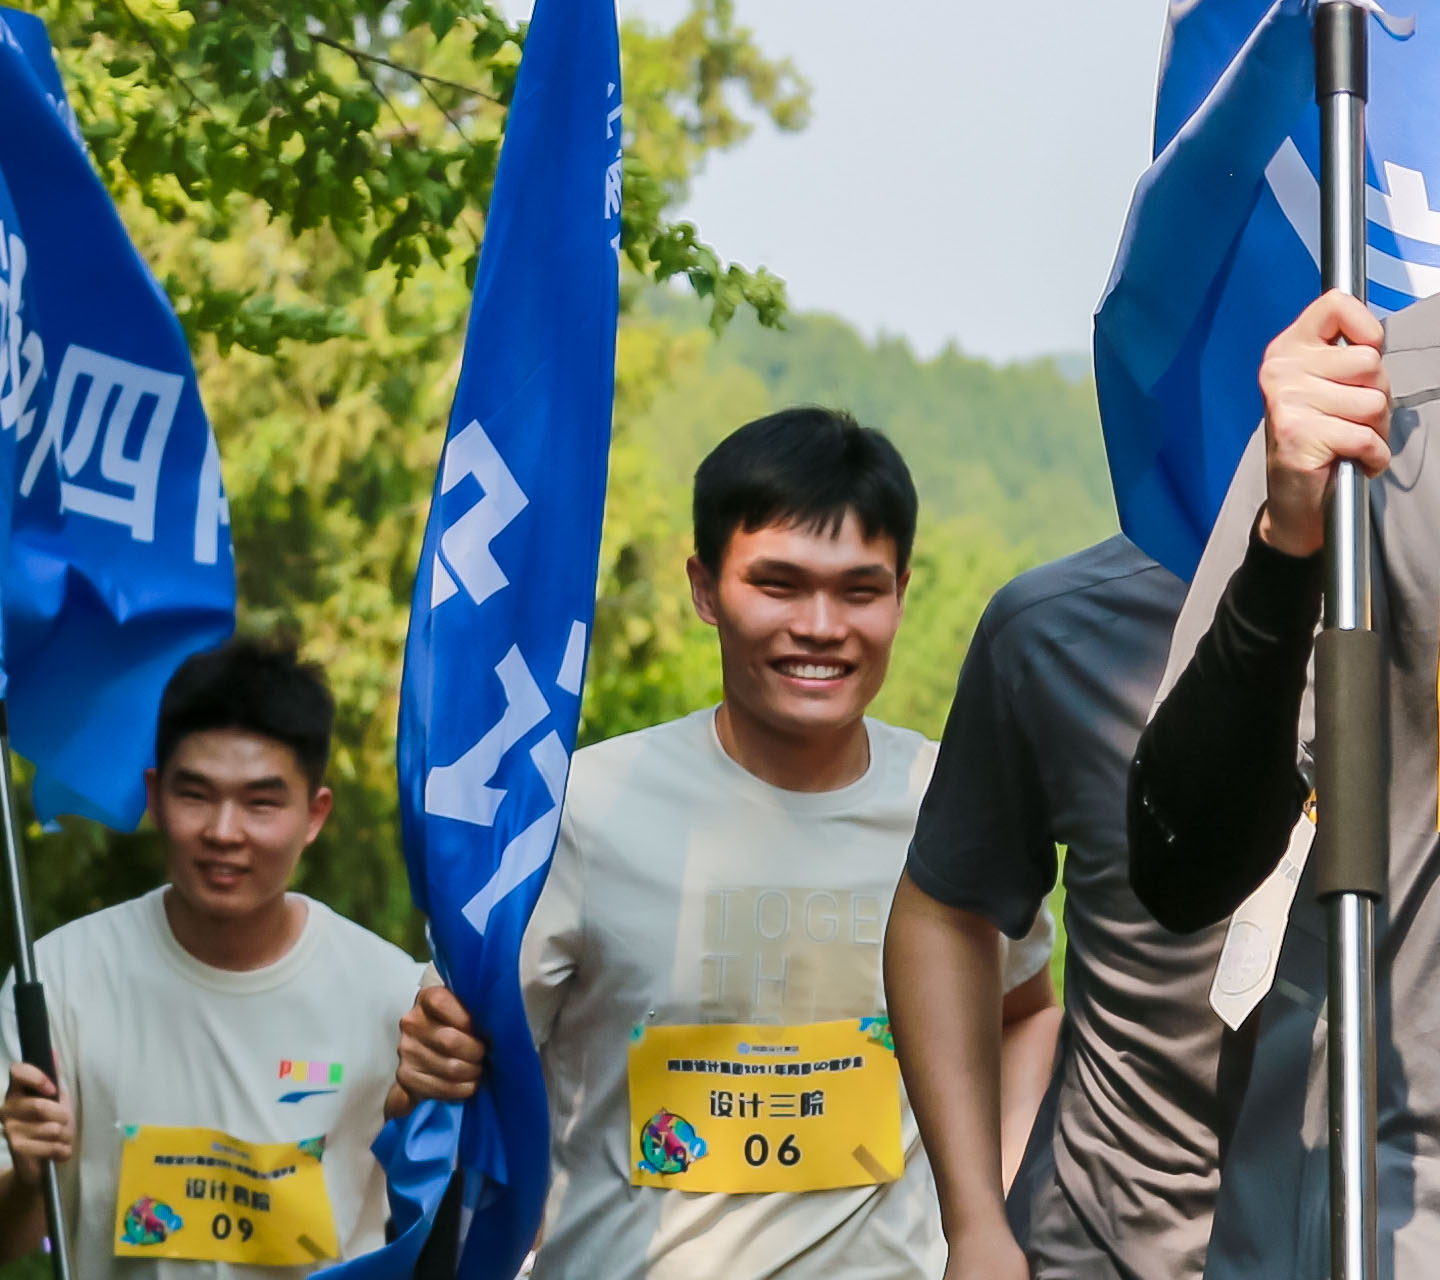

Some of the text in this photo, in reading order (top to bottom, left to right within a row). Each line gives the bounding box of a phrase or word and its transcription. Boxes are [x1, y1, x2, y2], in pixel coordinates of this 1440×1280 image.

[709, 1089, 825, 1119] 设计三院
[744, 1133, 802, 1167] 06
[211, 1213, 254, 1242] 09
